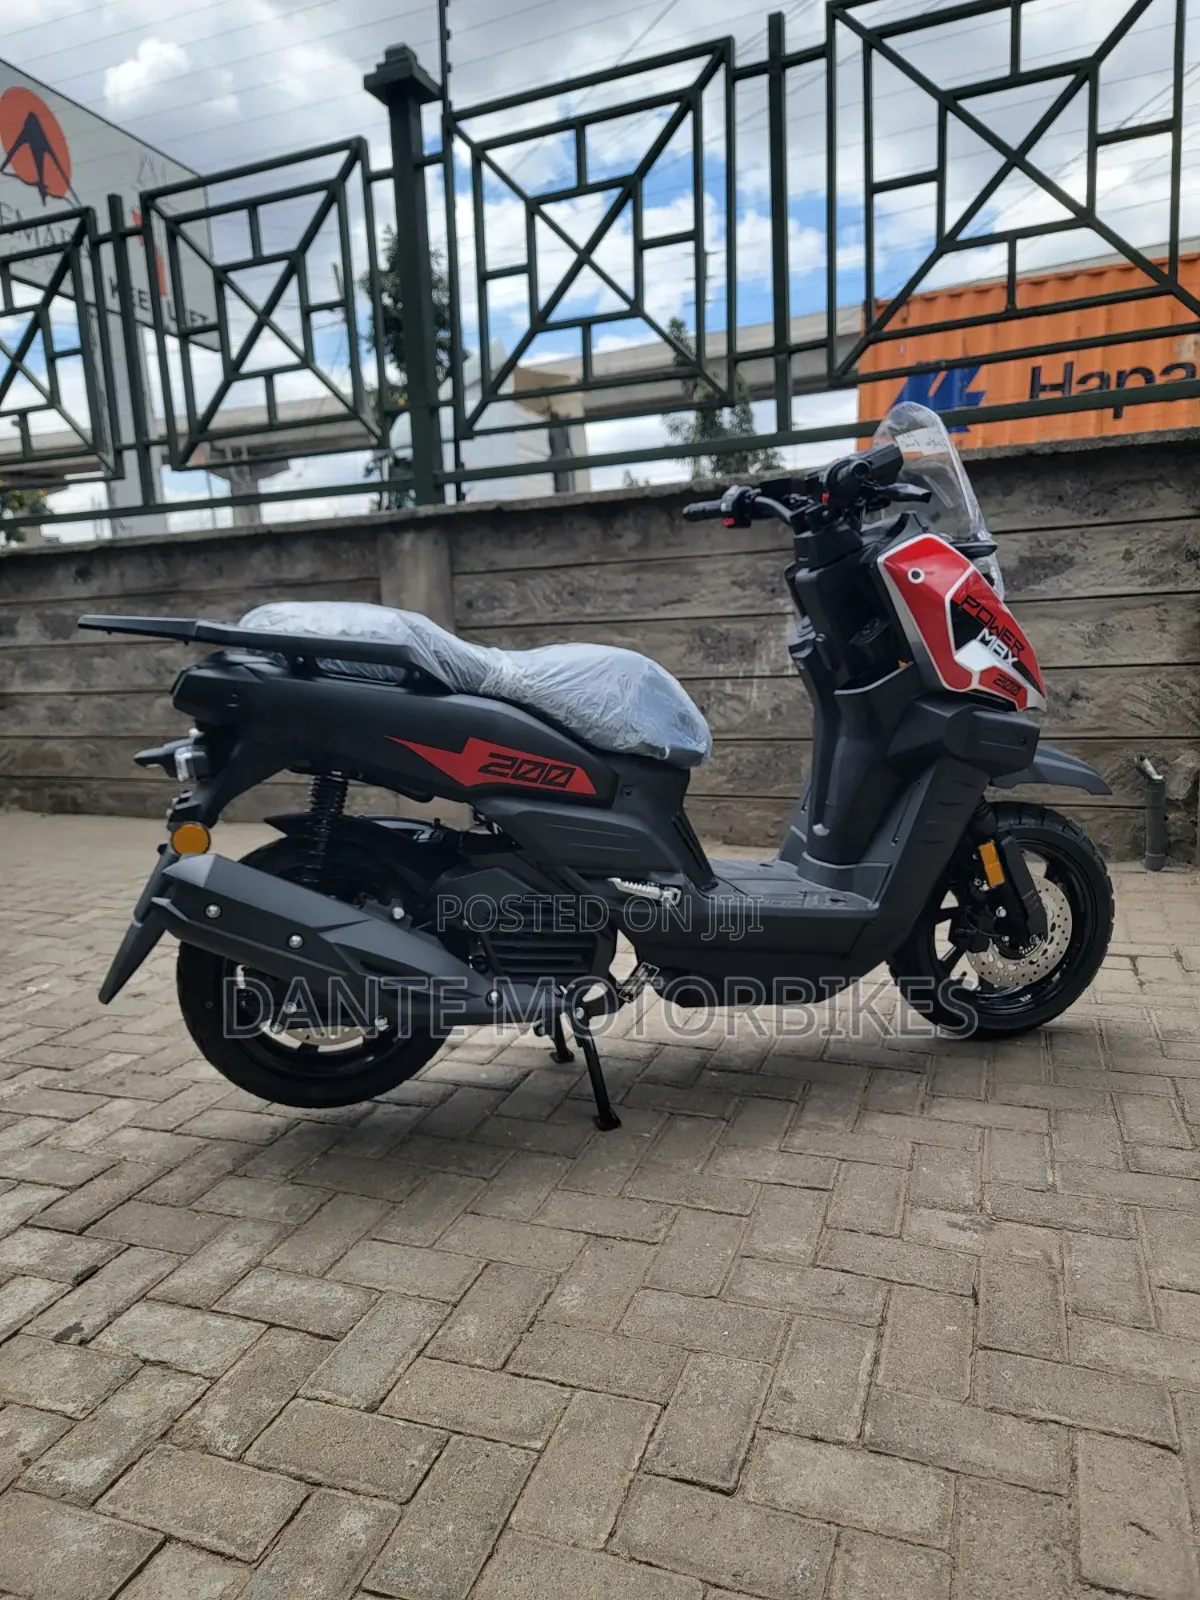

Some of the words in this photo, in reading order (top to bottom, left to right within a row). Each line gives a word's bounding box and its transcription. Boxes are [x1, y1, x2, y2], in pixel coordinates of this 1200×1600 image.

[959, 594, 1025, 658] POWER
[993, 673, 1022, 697] 200
[477, 752, 577, 788] 200
